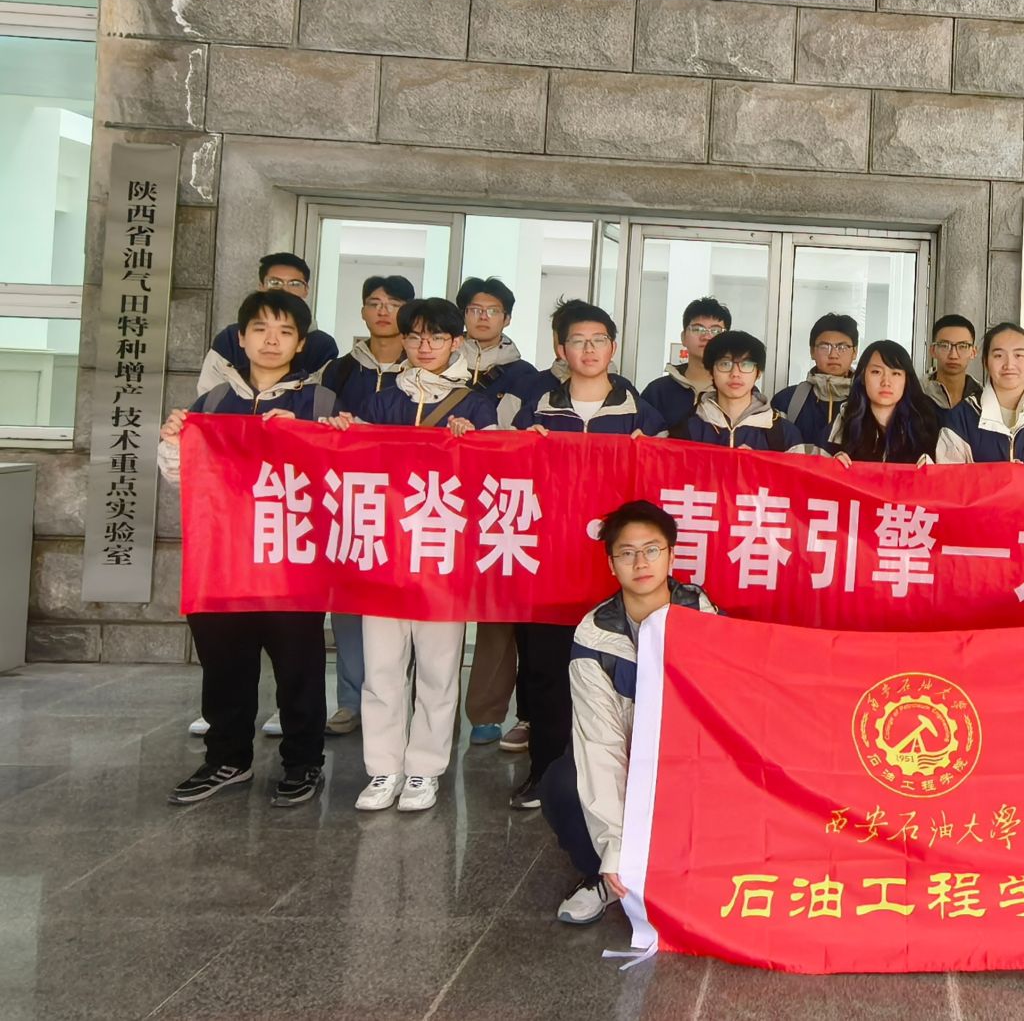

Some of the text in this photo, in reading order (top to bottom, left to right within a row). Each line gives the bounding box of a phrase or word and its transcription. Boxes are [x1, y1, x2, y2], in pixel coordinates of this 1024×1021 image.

[101, 180, 158, 566] 陕西省油气田特种增产技术重点实验室
[867, 753, 969, 792] 石油工程学院
